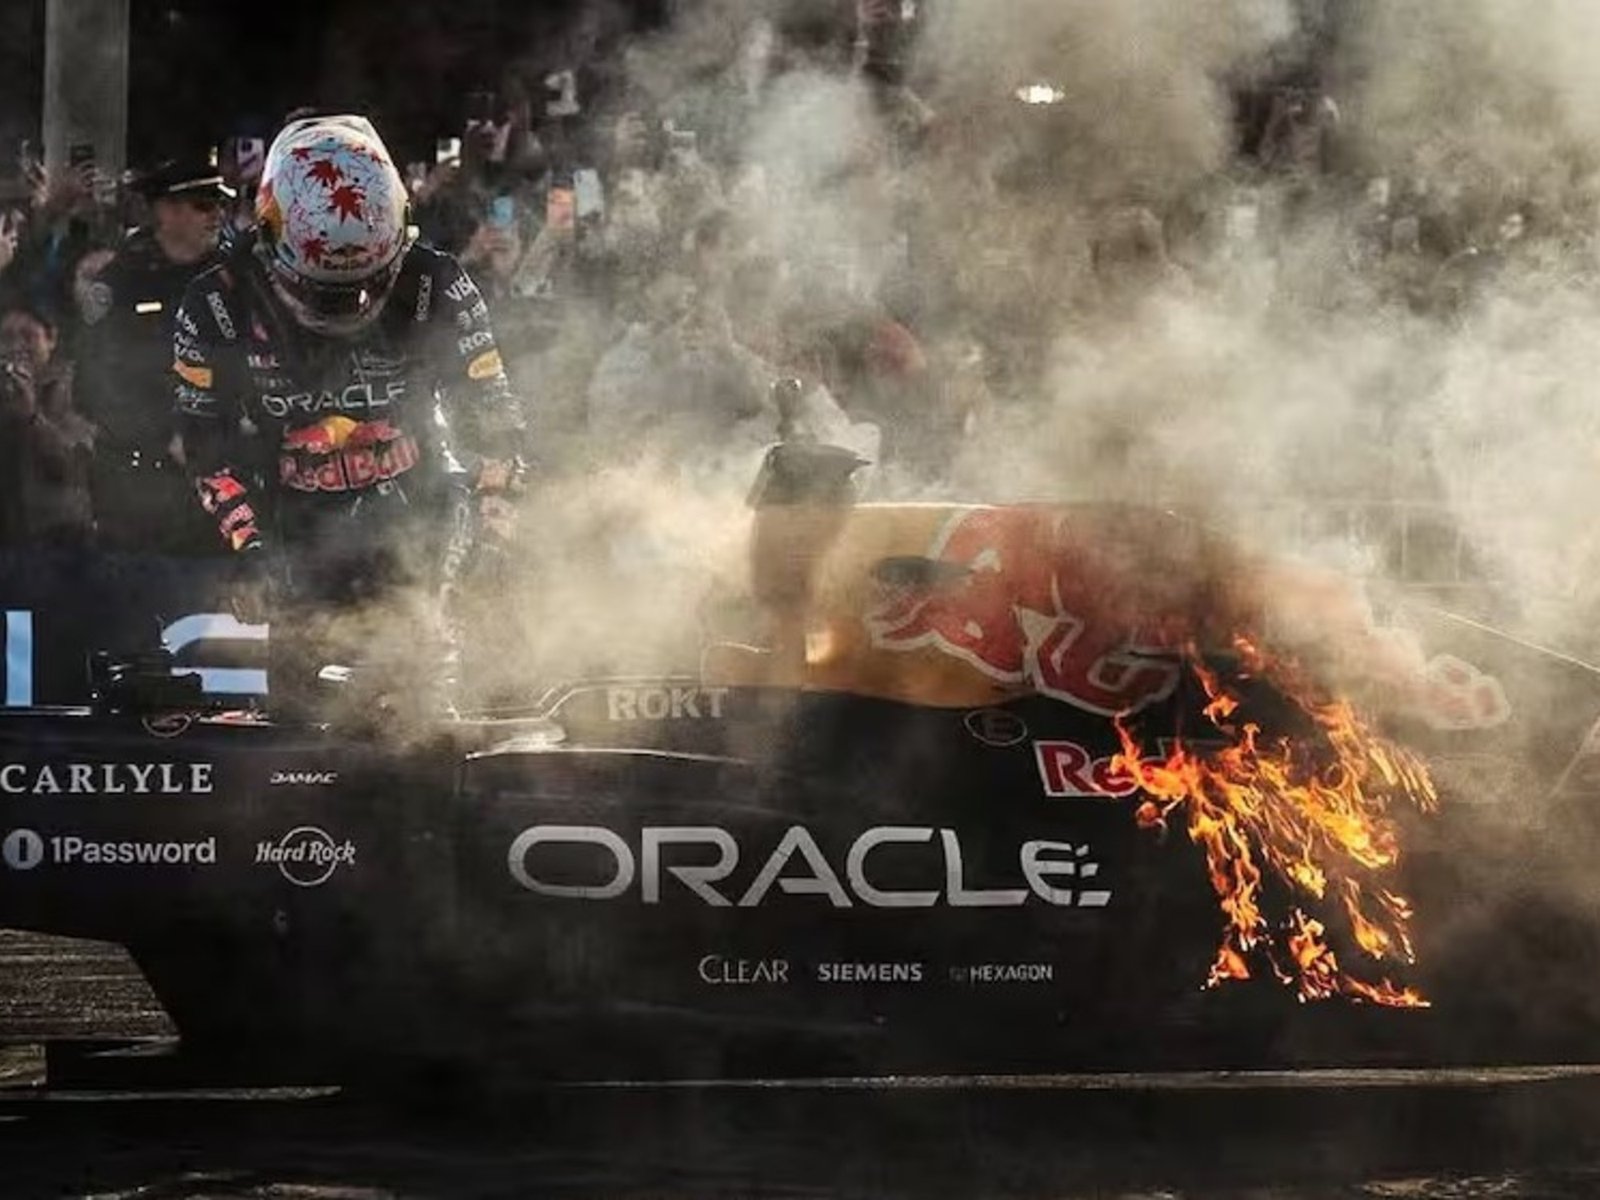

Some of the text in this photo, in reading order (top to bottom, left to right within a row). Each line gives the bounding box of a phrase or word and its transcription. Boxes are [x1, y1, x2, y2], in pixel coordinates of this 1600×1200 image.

[608, 686, 729, 720] ROKT
[0, 763, 213, 793] CARLYLE
[1034, 740, 1180, 798] Re
[50, 836, 216, 863] 1Password
[255, 840, 356, 866] Hard Rock
[508, 825, 1112, 907] ORACLE
[698, 955, 1053, 983] CLEAR SIEMENS HEXAGON
